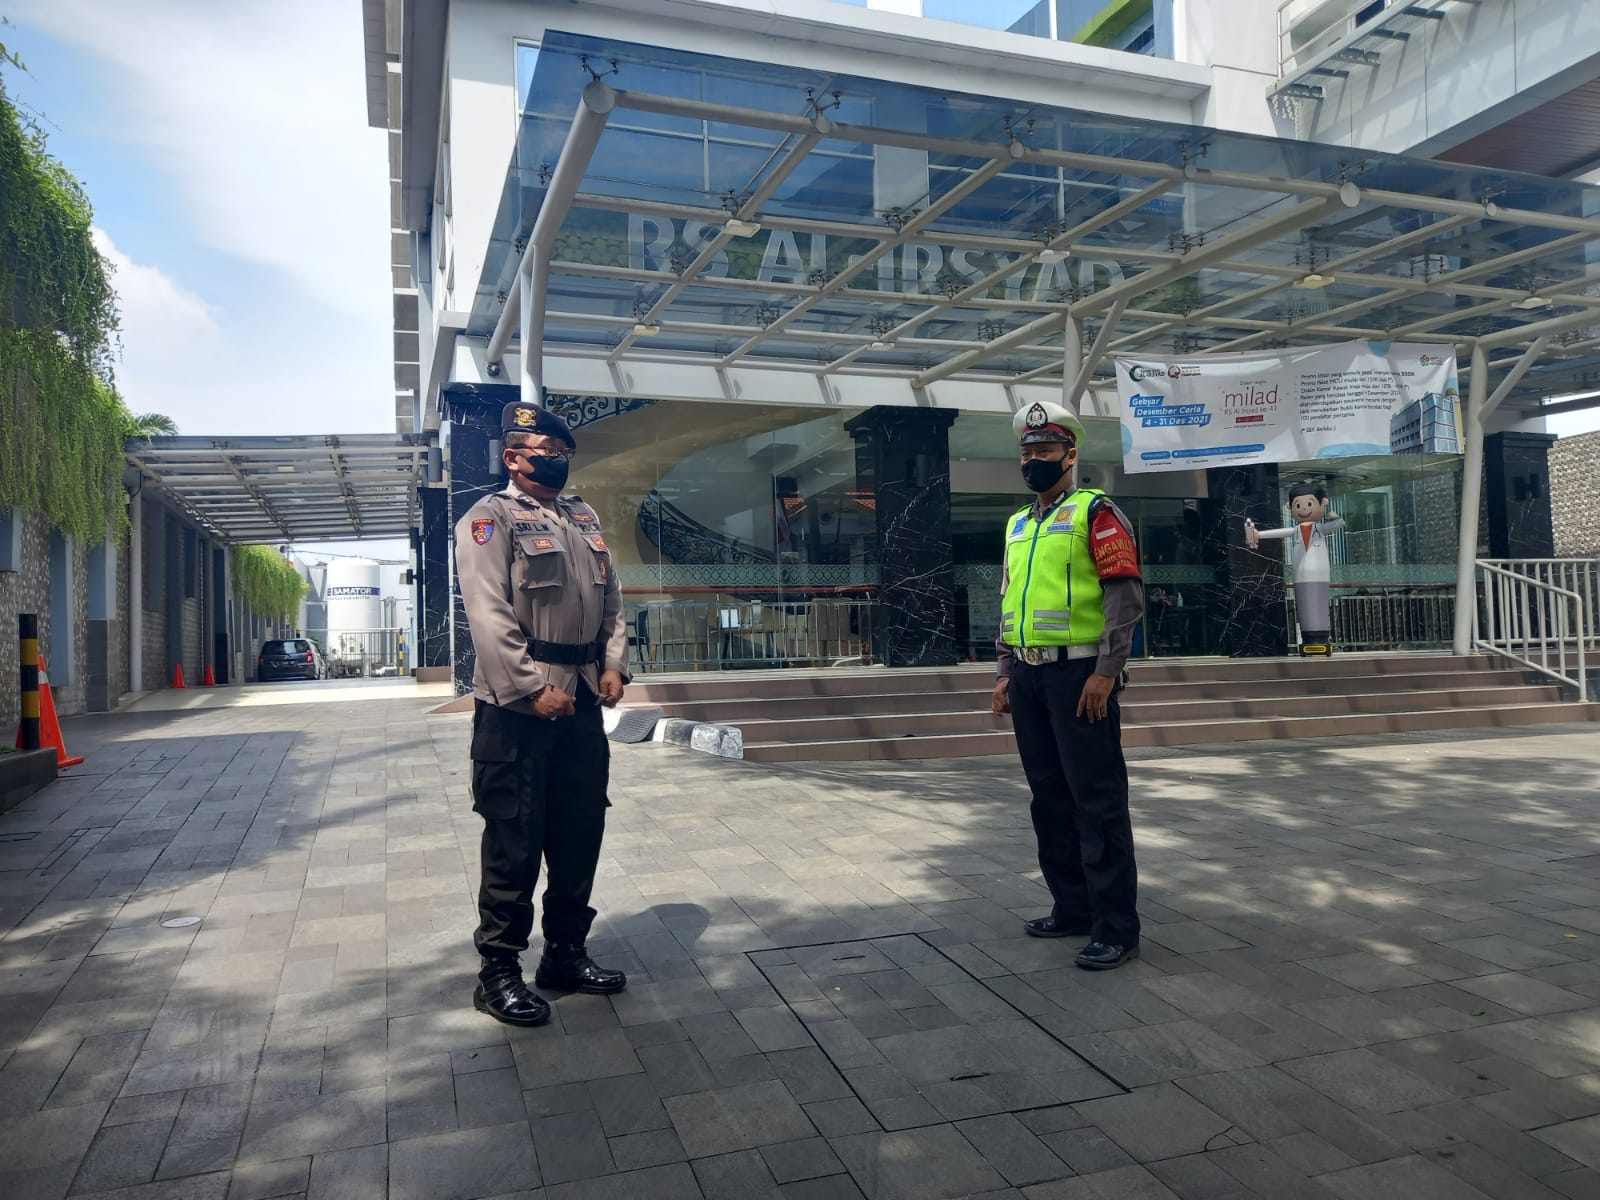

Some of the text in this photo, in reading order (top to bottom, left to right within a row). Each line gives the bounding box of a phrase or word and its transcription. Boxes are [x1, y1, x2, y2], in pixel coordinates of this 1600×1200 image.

[628, 212, 729, 279] RS
[1225, 384, 1278, 408] milad
[1132, 398, 1160, 407] Gebyar
[1136, 406, 1201, 416] Desember Ceria
[1145, 418, 1151, 426] 4
[1160, 418, 1167, 426] 31
[1188, 416, 1209, 424] 2021
[515, 522, 532, 532] SRI
[333, 587, 371, 595] SAMATOR
